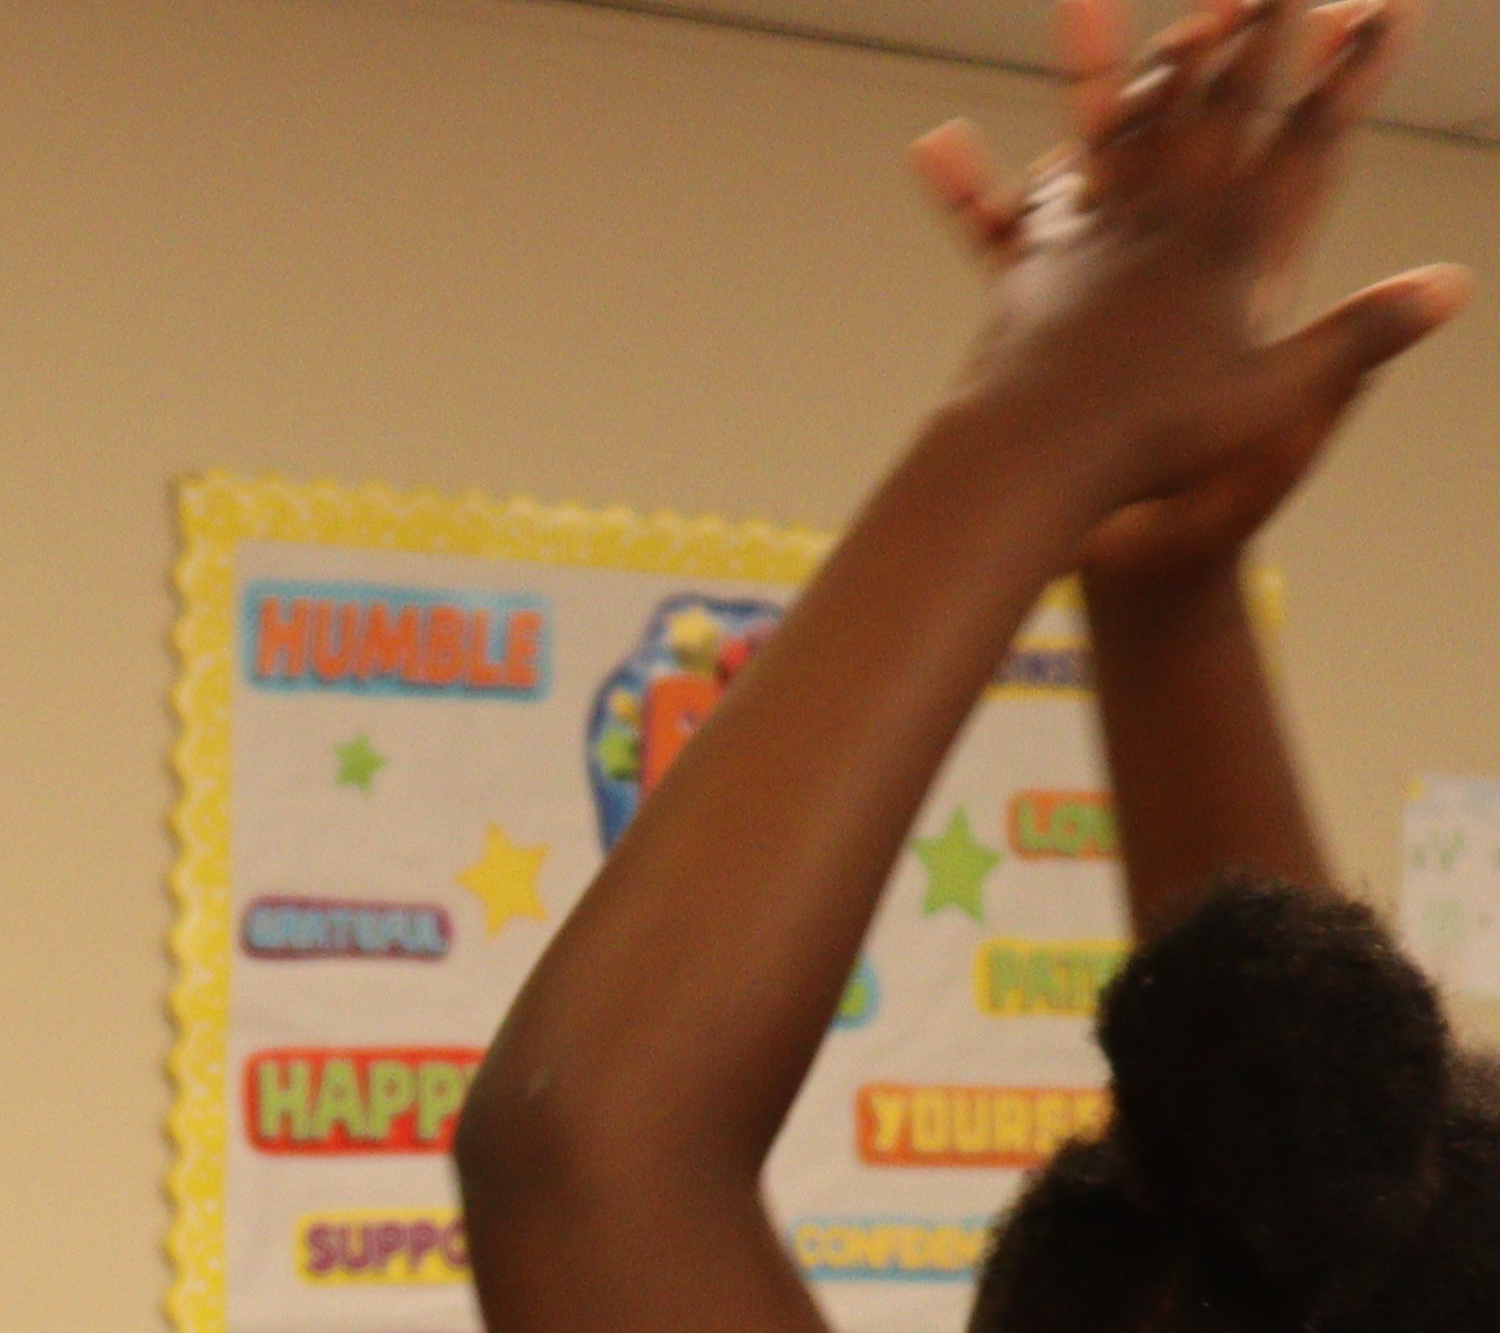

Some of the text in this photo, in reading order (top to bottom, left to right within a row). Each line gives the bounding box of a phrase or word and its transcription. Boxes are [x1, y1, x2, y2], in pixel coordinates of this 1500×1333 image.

[257, 596, 544, 688] HUMBLE
[258, 1056, 476, 1139] HAPP
[307, 1218, 468, 1275] SUPPO
